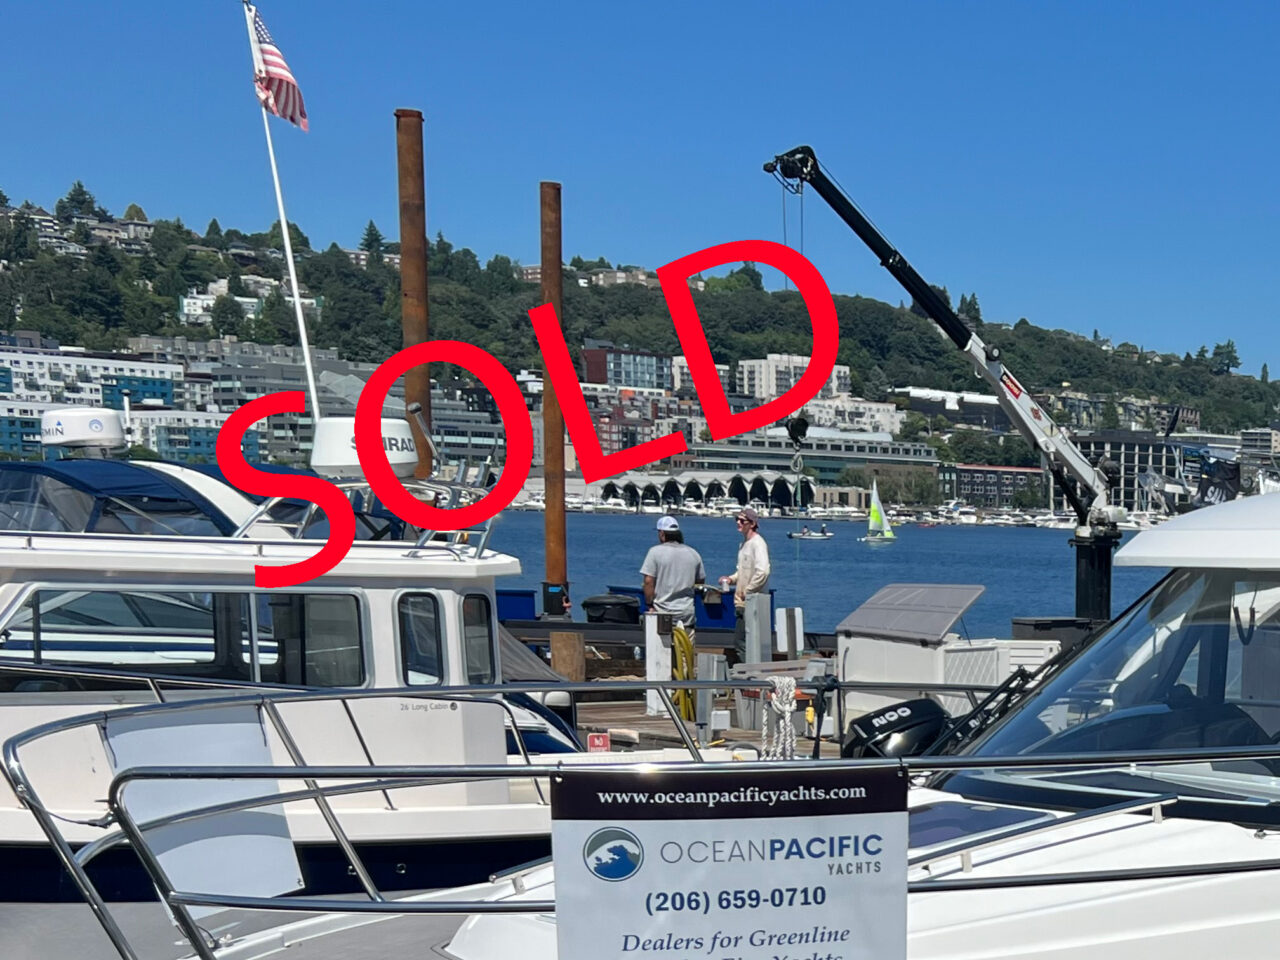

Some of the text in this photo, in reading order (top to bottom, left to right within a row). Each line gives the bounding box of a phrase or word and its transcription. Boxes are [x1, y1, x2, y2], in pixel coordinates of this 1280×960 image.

[597, 785, 867, 807] www.oceanpacificyachts.com
[828, 861, 882, 875] YACHTS
[645, 886, 826, 915] (206) 659-0710
[622, 926, 851, 954] Dealers for Greenline
